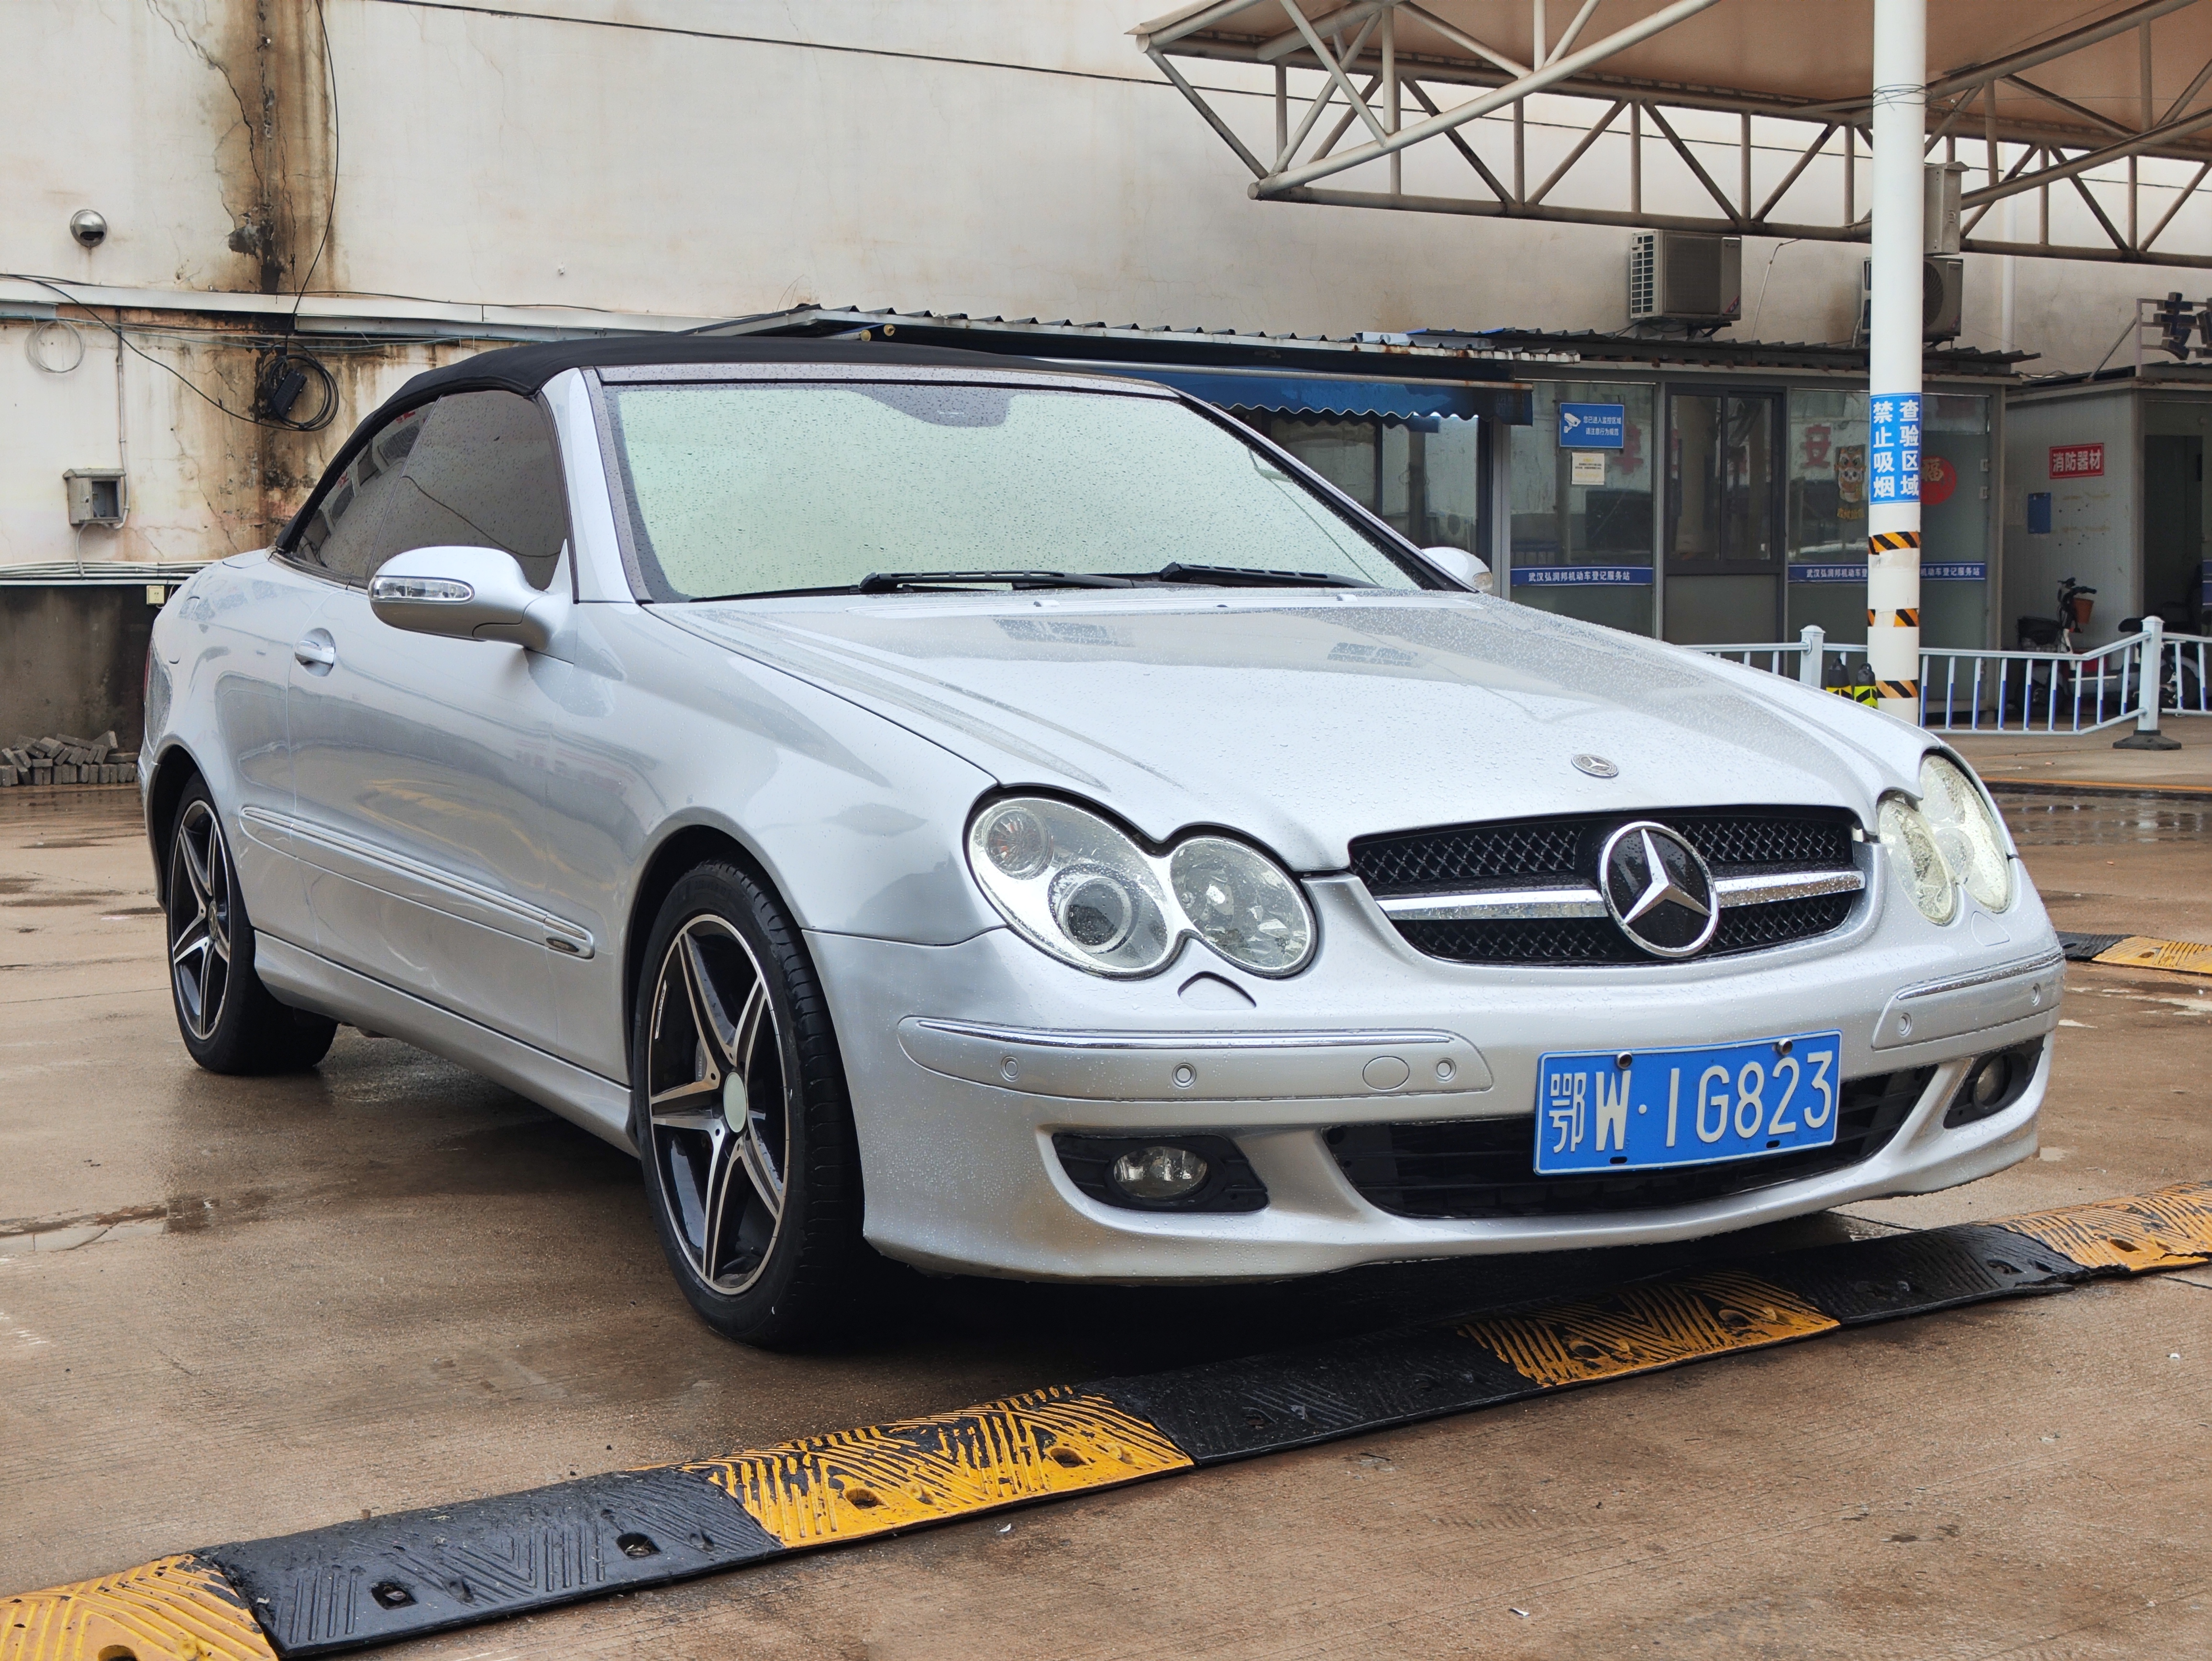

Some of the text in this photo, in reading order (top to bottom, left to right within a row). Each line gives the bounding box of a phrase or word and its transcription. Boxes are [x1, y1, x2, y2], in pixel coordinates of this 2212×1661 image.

[1873, 400, 1894, 498] 禁止吸烟
[1899, 399, 1919, 496] 查验区域
[2053, 449, 2101, 472] 消防器材
